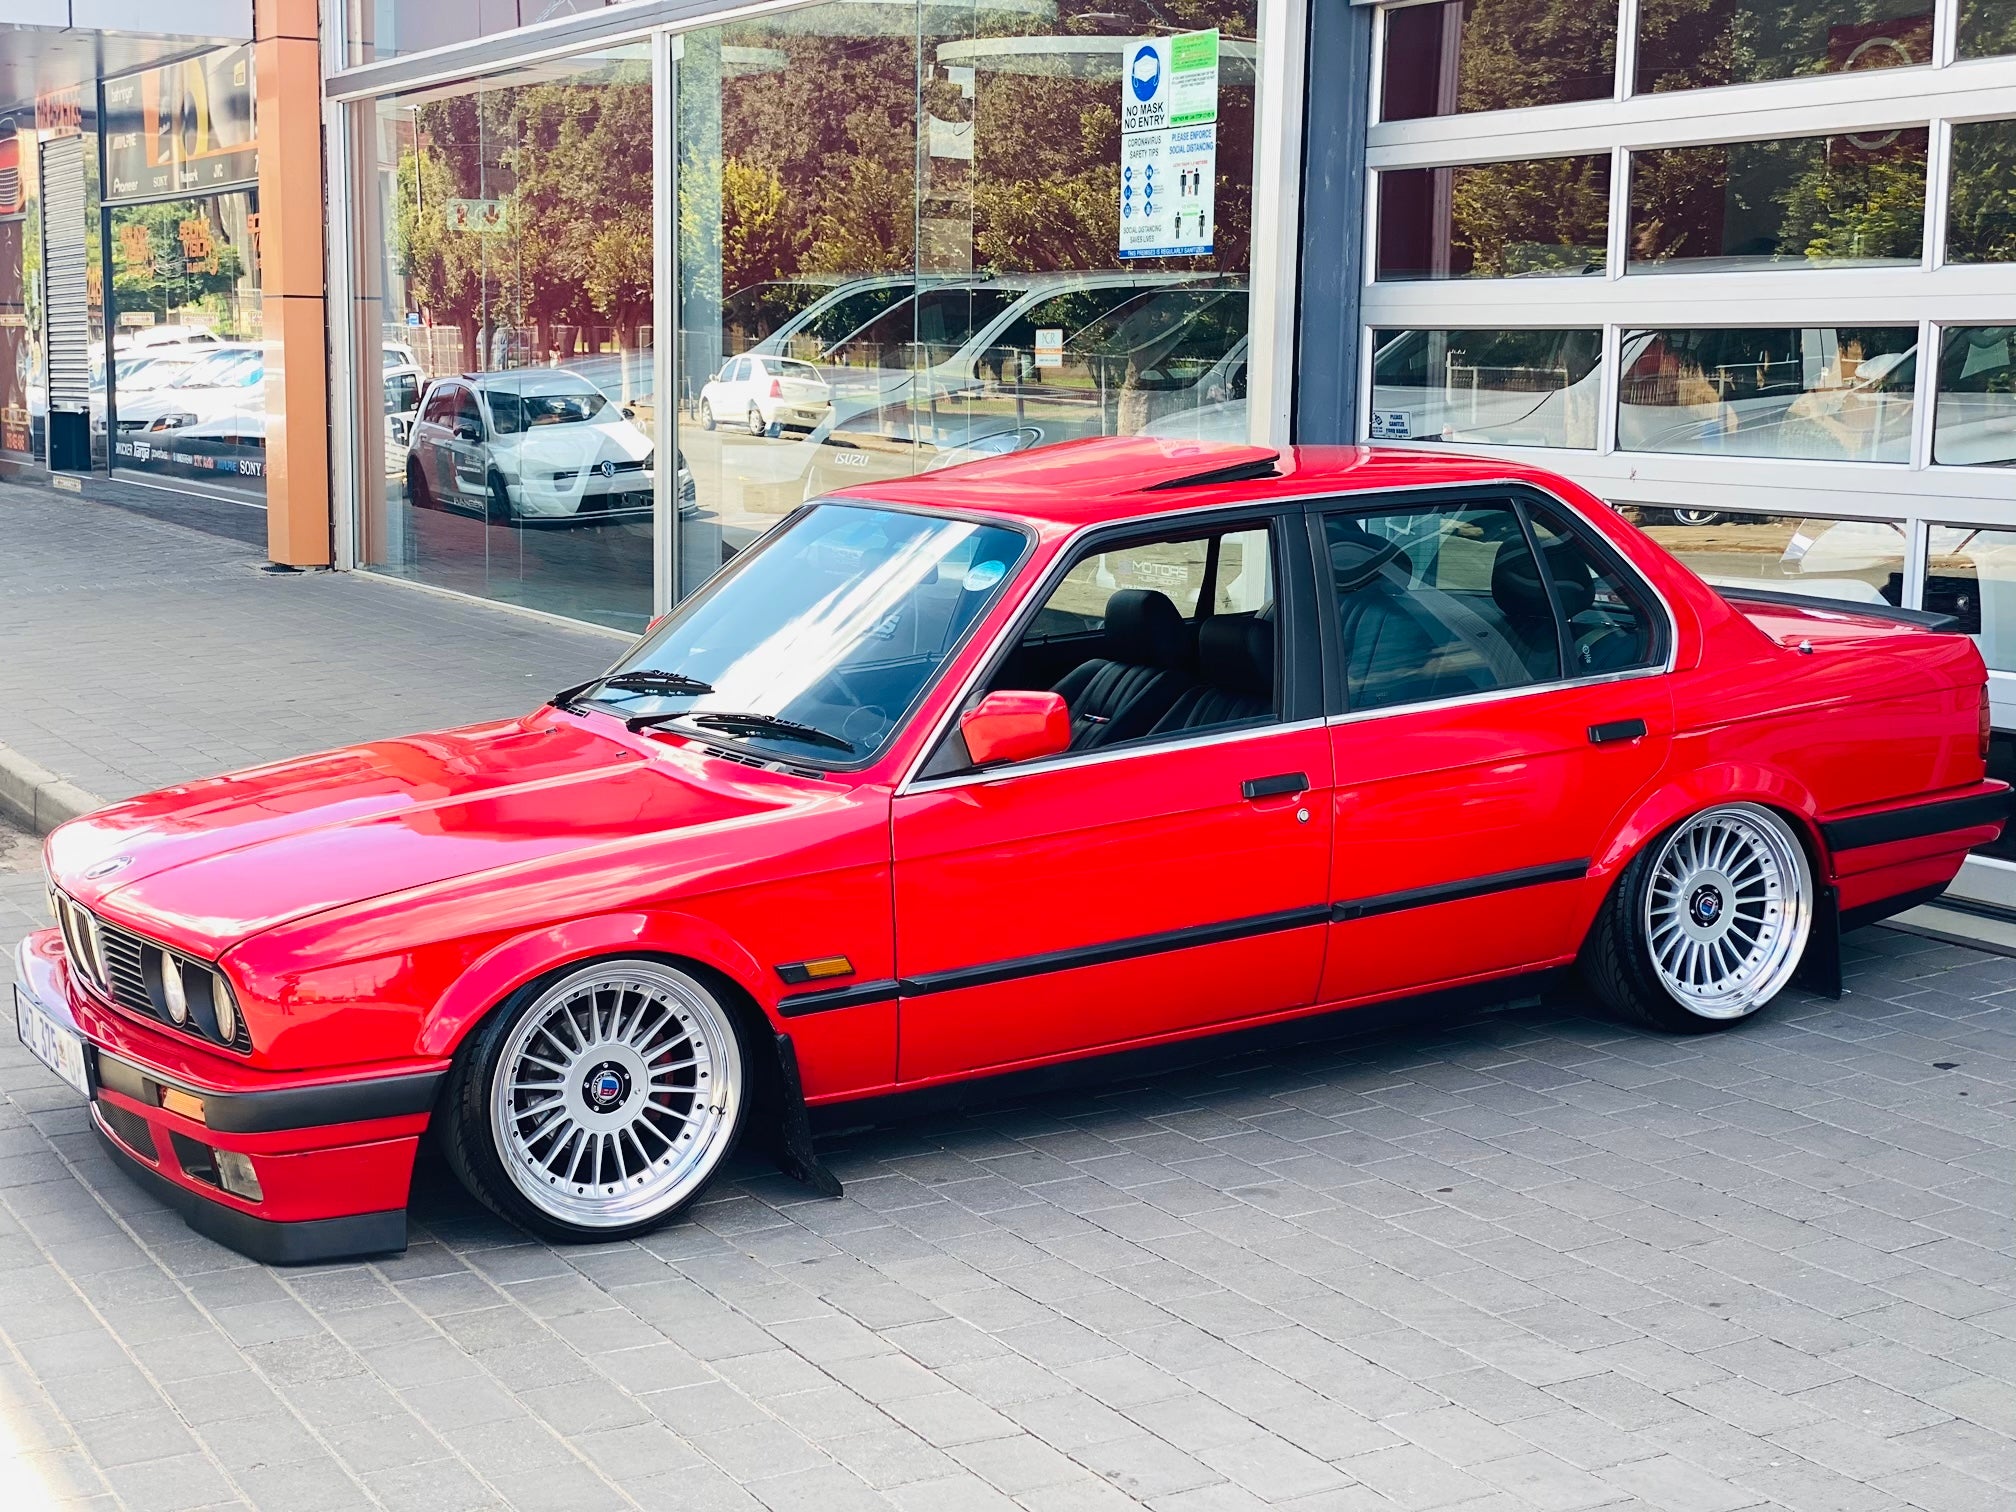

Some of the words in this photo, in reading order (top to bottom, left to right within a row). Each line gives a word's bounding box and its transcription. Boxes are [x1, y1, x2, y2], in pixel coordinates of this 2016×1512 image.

[1126, 105, 1138, 117] NO
[1140, 102, 1164, 115] MASK
[1124, 118, 1137, 129] NO
[1138, 114, 1165, 128] ENTRY
[1127, 135, 1162, 148] CORONAVIRUS
[1171, 131, 1190, 142] PLEASE
[1190, 129, 1212, 140] ENFORCE
[1129, 149, 1148, 159] SAFETY
[1148, 147, 1159, 158] TIPS
[1169, 144, 1186, 155] SOCIAL
[1186, 141, 1214, 153] DISTANCING
[113, 178, 138, 193] Pioneer
[133, 441, 150, 462] Targa
[834, 452, 870, 467] ISUZU
[239, 460, 261, 477] SONY
[1132, 560, 1189, 579] MOTORS
[39, 1016, 60, 1069] 375
